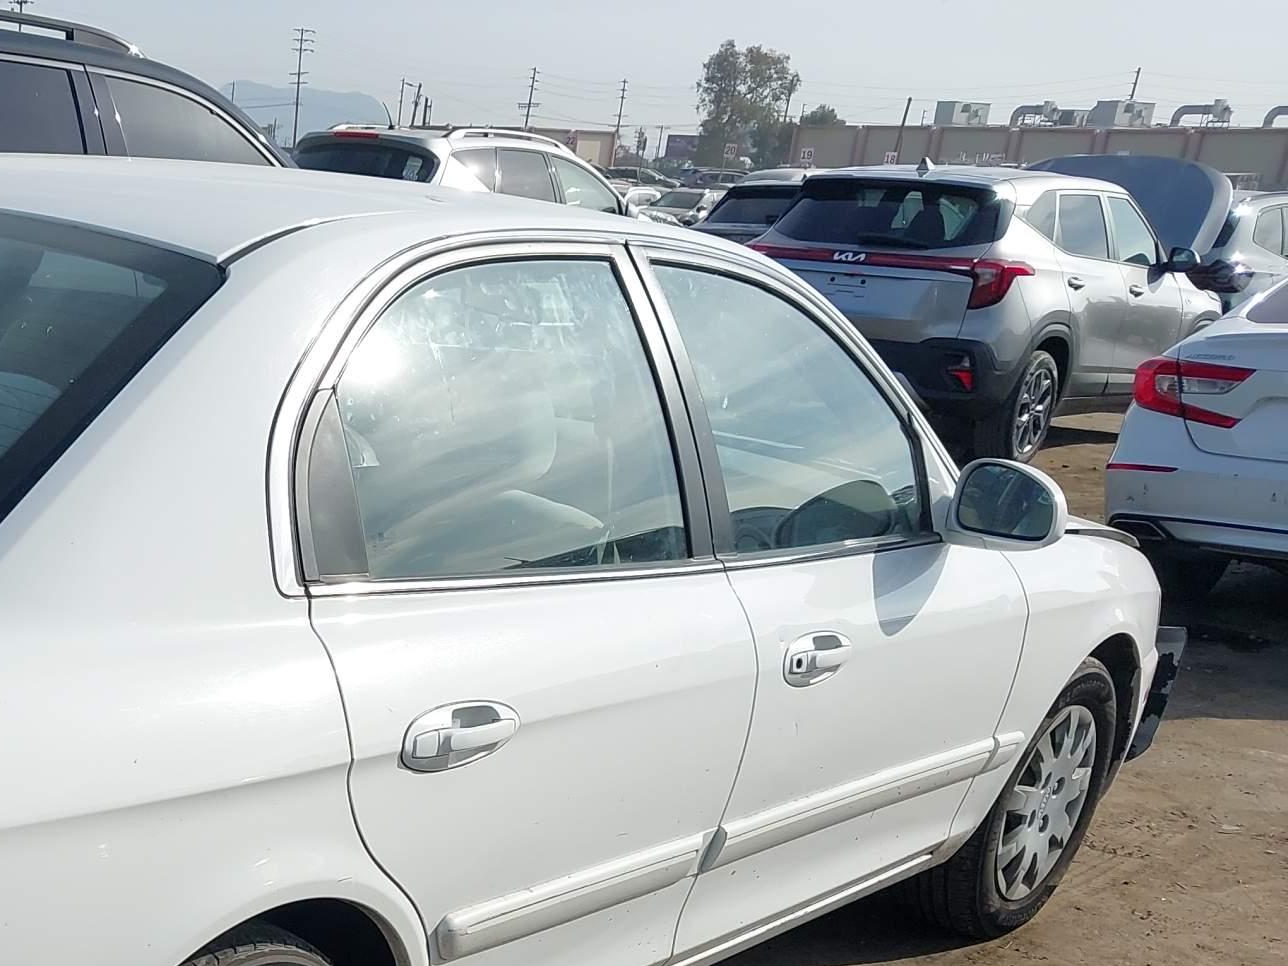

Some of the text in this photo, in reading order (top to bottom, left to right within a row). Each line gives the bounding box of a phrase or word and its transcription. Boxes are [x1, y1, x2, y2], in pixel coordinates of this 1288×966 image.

[725, 145, 736, 156] 20
[801, 150, 813, 160] 19
[884, 153, 896, 164] 18
[833, 251, 866, 262] KIA
